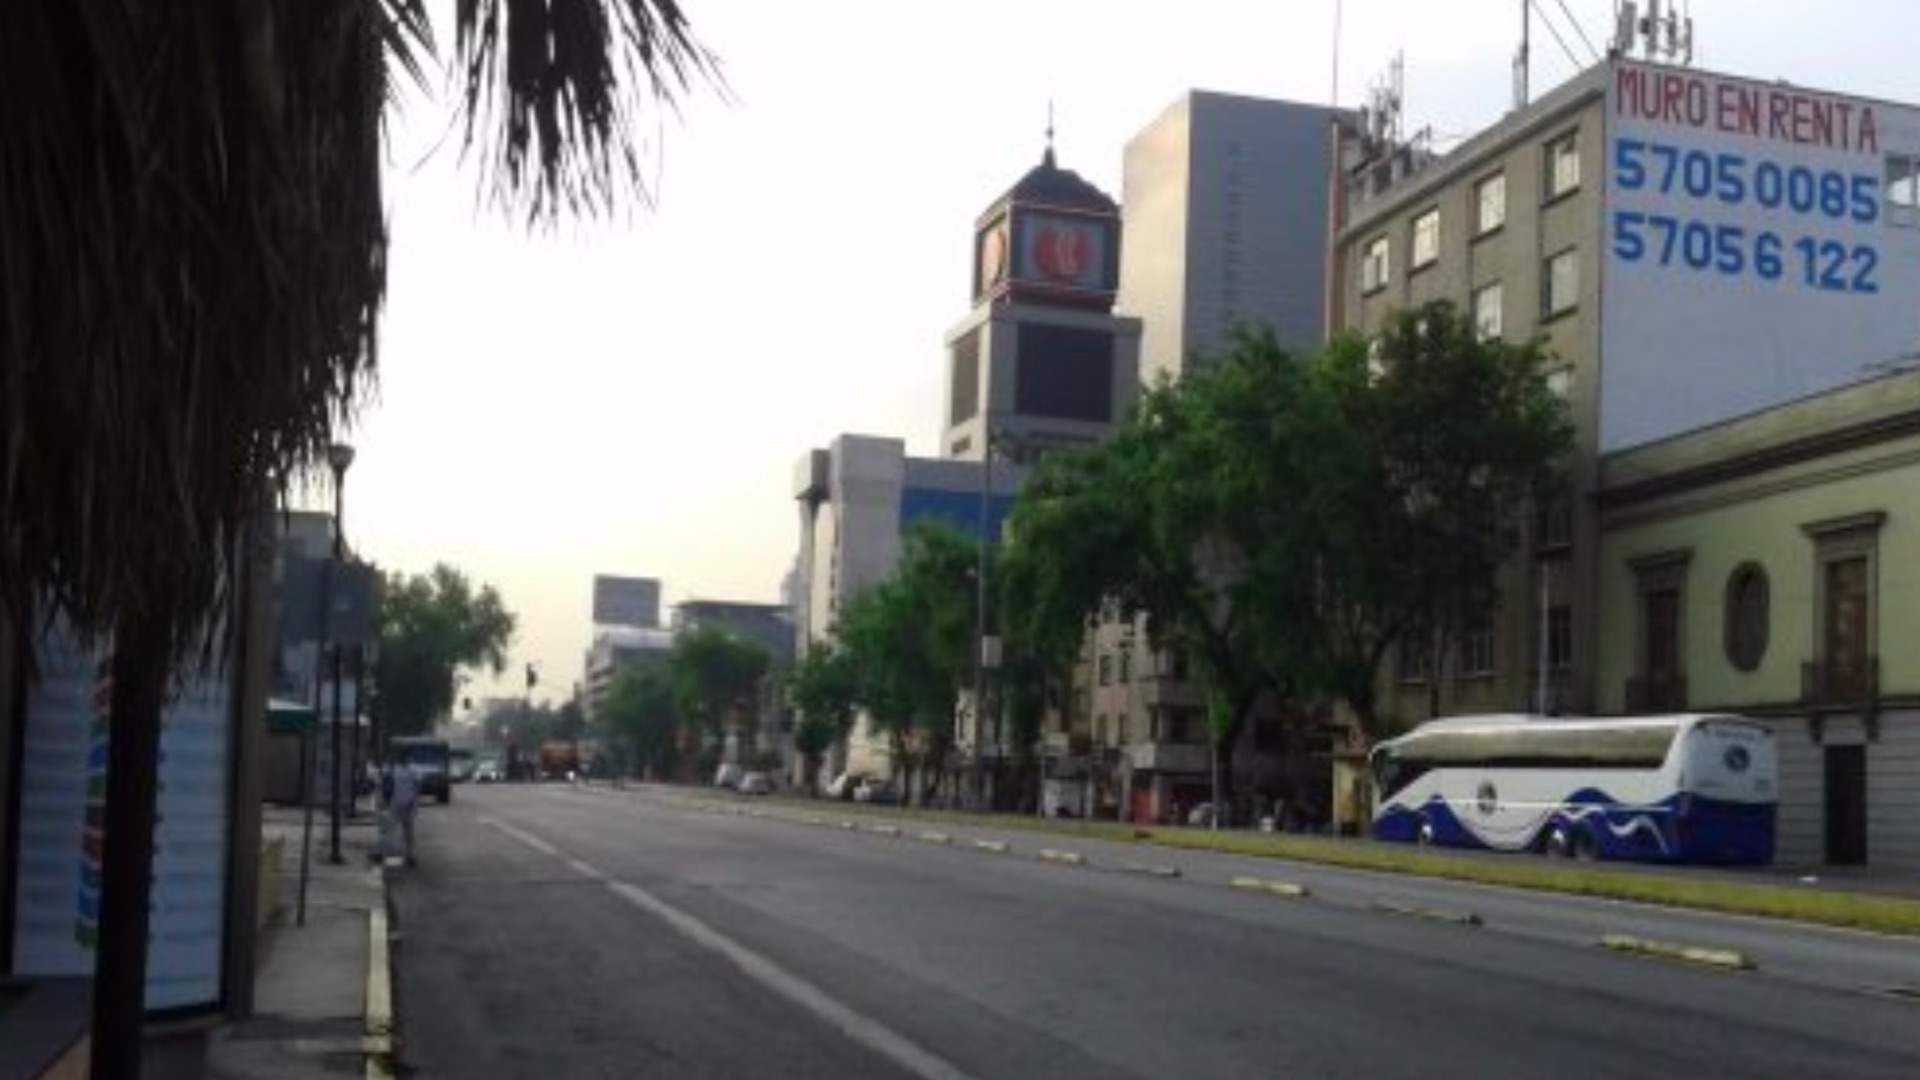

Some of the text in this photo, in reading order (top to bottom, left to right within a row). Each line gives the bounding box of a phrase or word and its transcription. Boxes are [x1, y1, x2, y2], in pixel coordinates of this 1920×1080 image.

[1616, 67, 1877, 154] MURO EN RENTA
